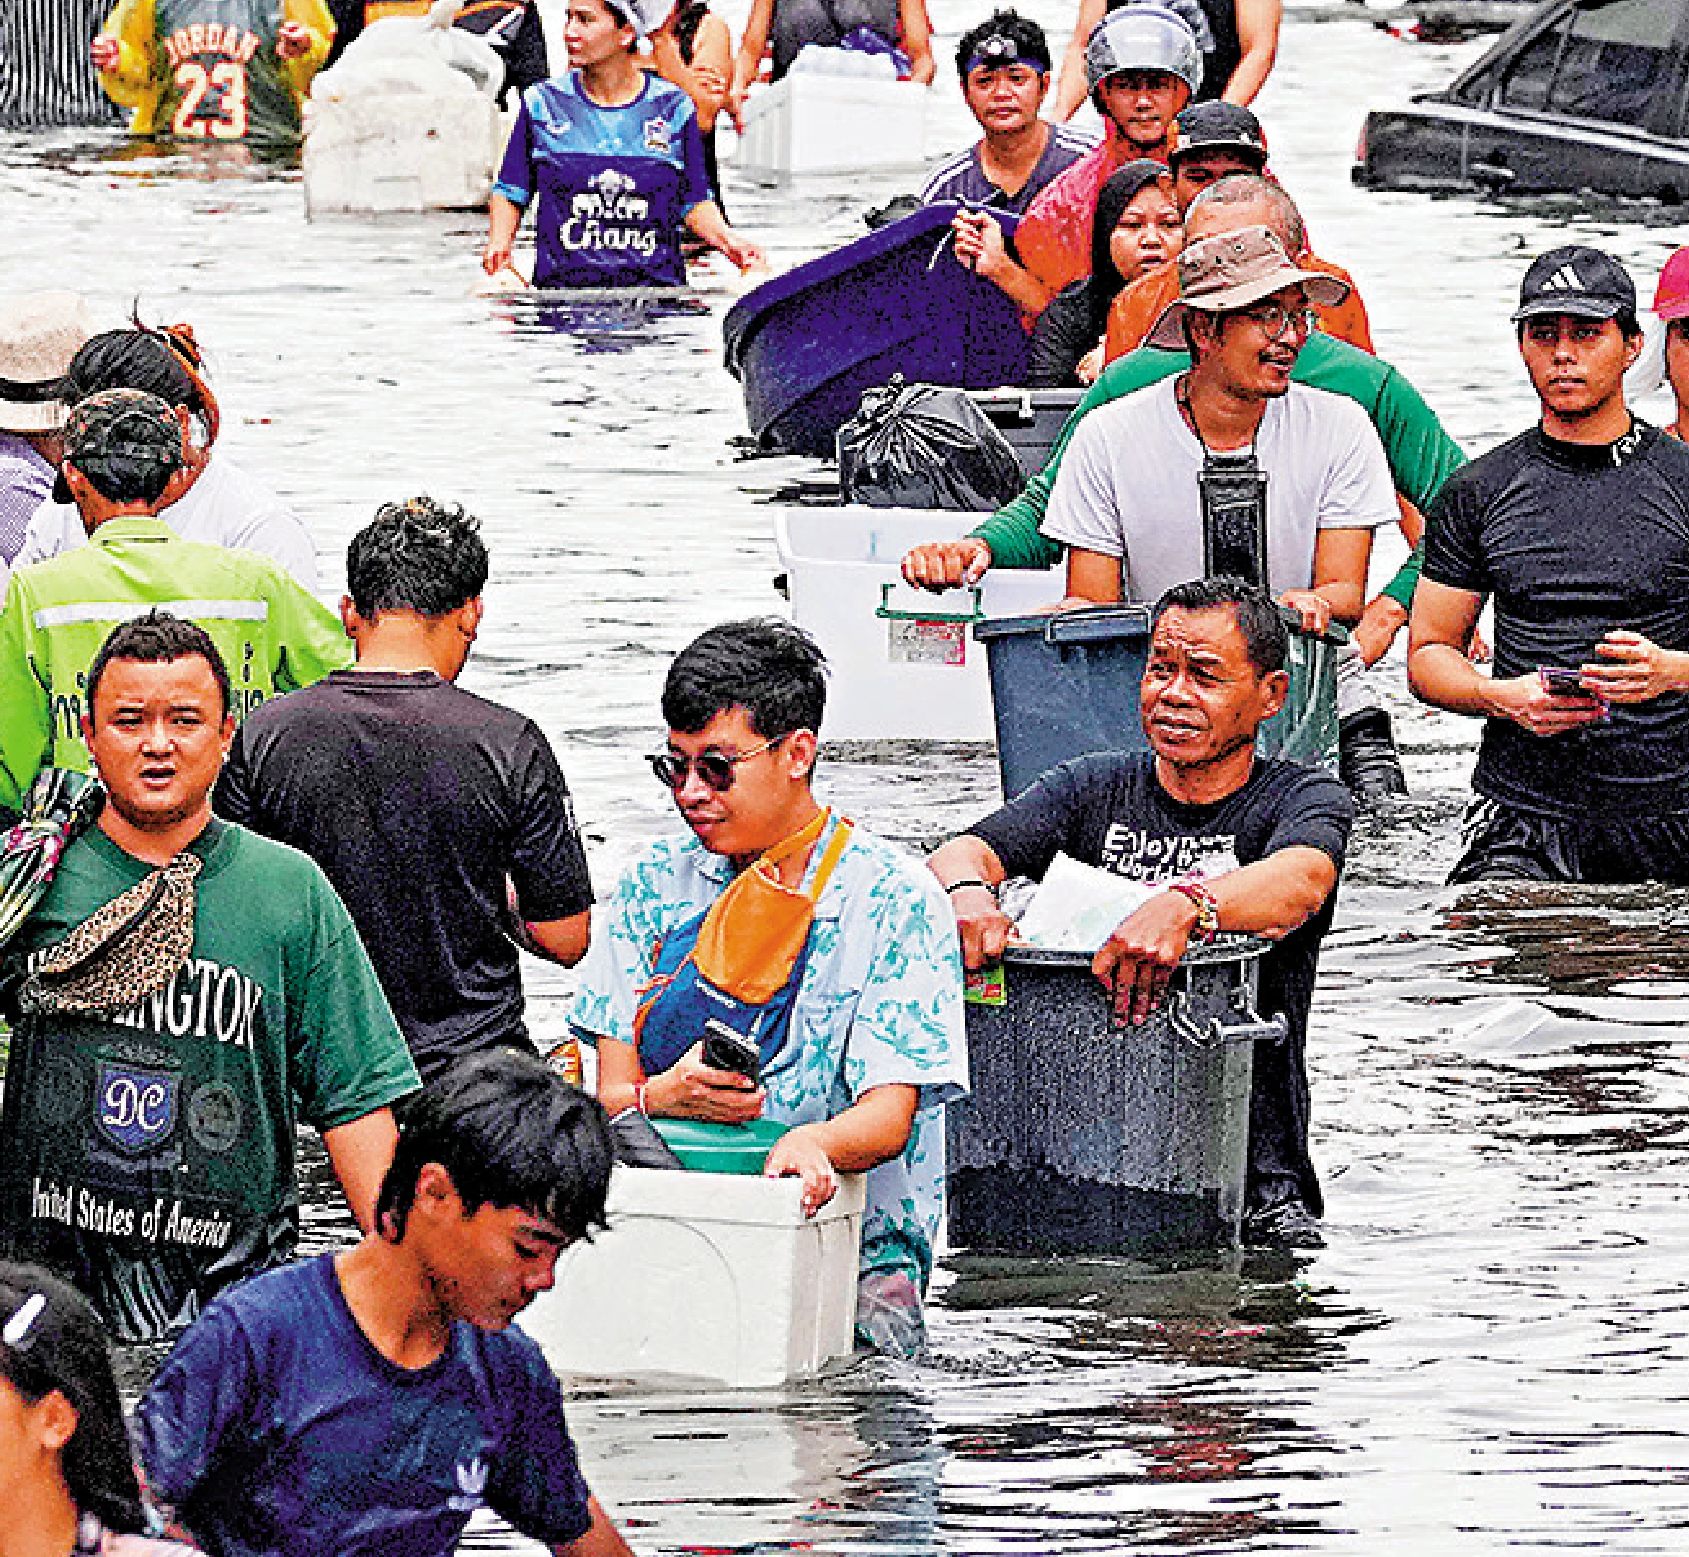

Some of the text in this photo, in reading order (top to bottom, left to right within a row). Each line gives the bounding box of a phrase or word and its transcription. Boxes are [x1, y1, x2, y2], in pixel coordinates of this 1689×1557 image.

[165, 22, 261, 66] JORDAN
[172, 61, 249, 138] 23
[560, 218, 656, 257] Chang
[102, 1079, 165, 1130] DC
[77, 1188, 135, 1236] States
[141, 1198, 164, 1242] of
